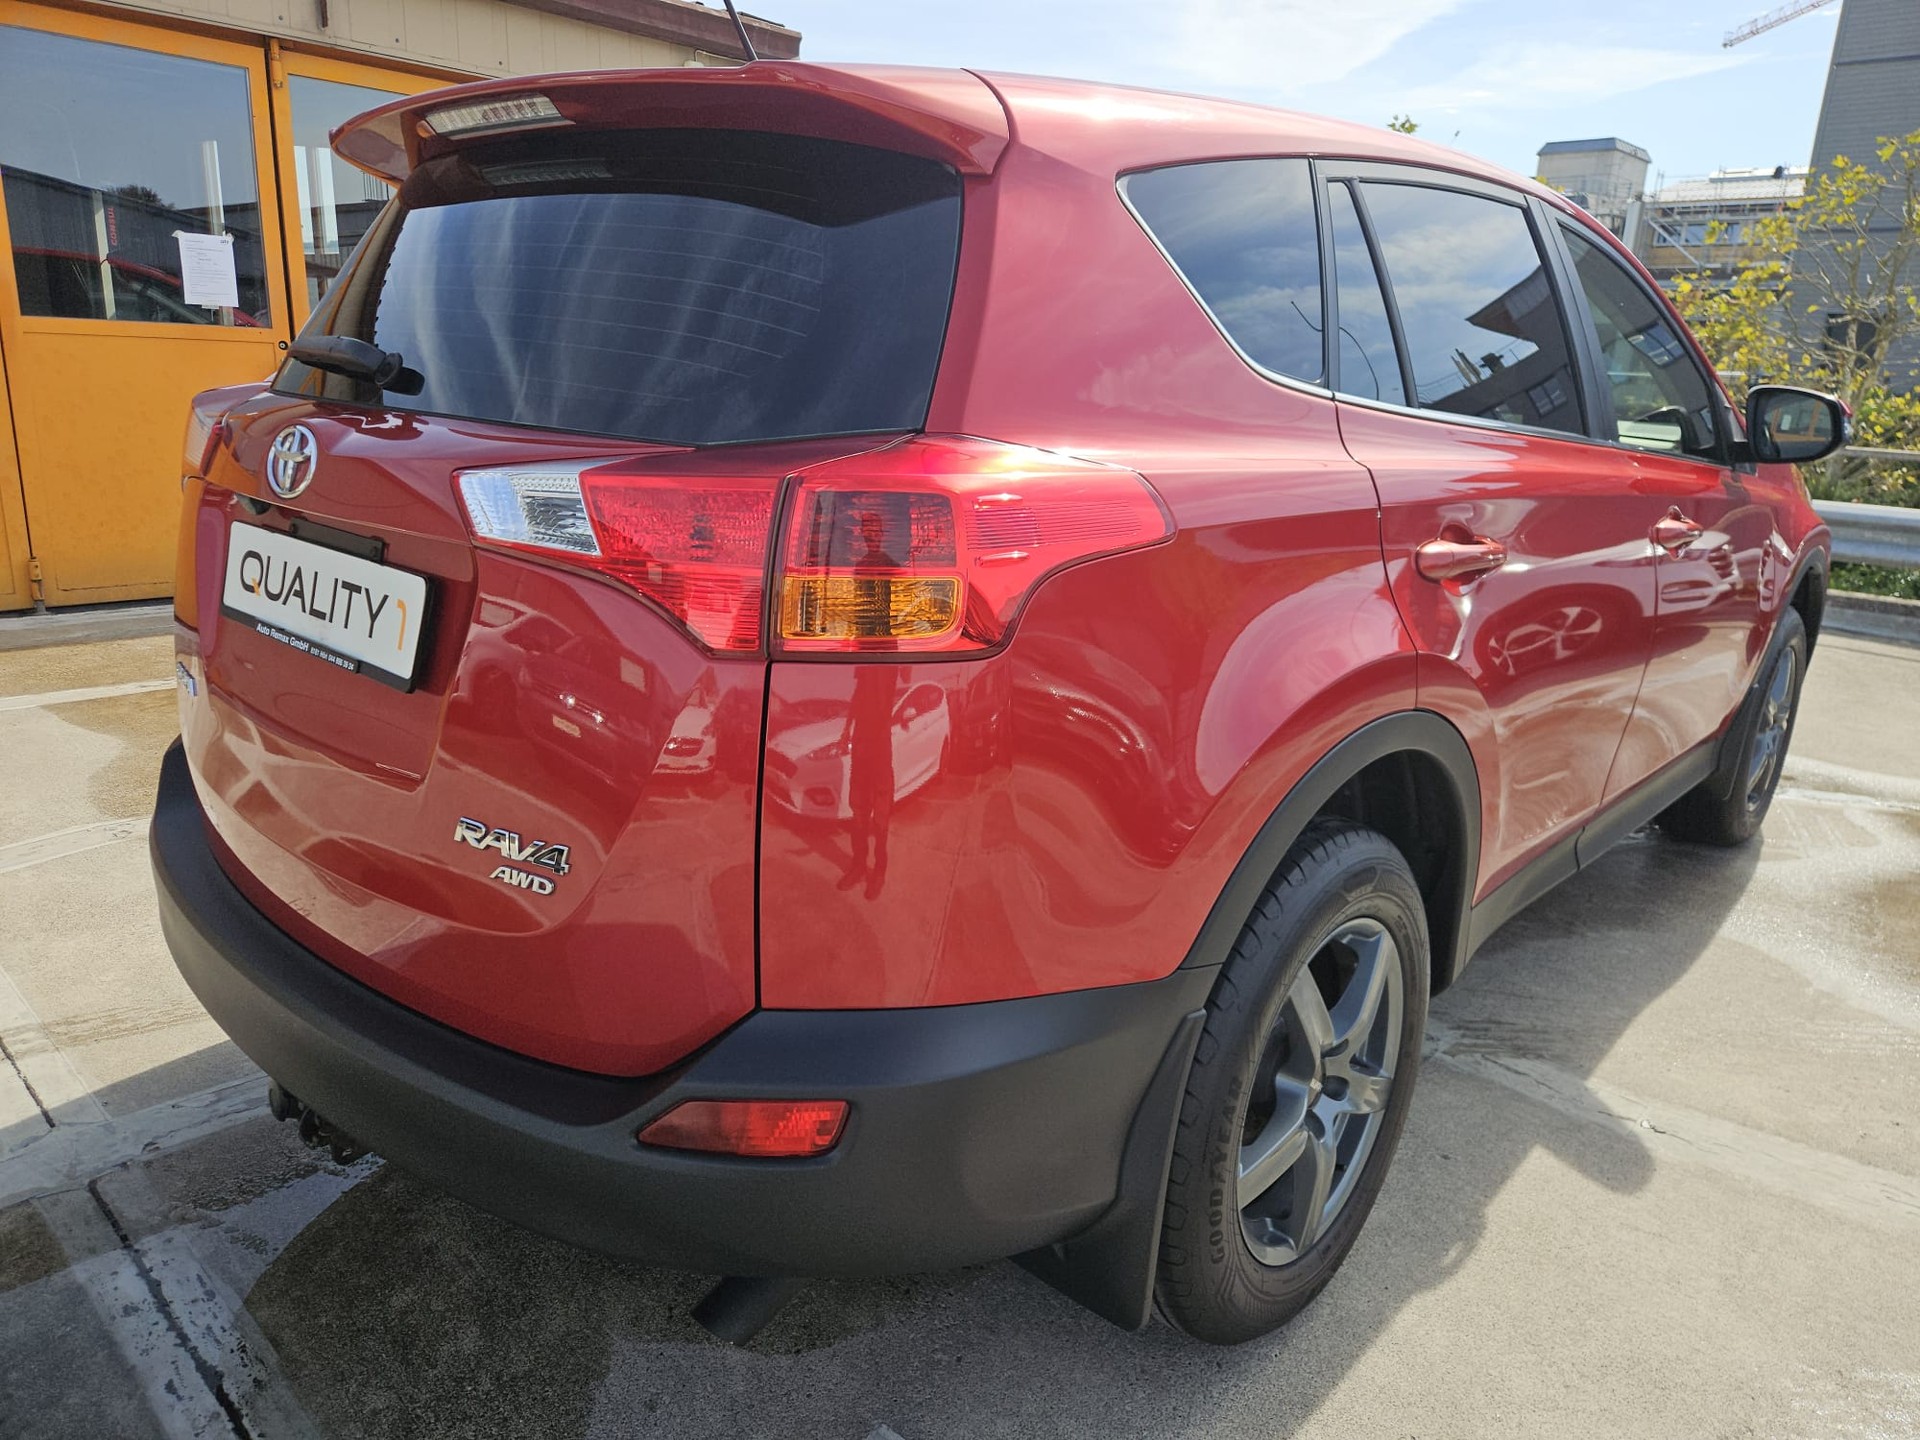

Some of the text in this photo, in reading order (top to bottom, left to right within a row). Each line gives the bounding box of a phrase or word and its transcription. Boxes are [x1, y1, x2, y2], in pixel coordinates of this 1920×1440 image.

[256, 623, 270, 636] Auto
[290, 636, 309, 651] GmbH
[453, 816, 571, 876] RAV4
[488, 866, 555, 895] AWD
[1209, 1075, 1243, 1265] GOODYEAR
